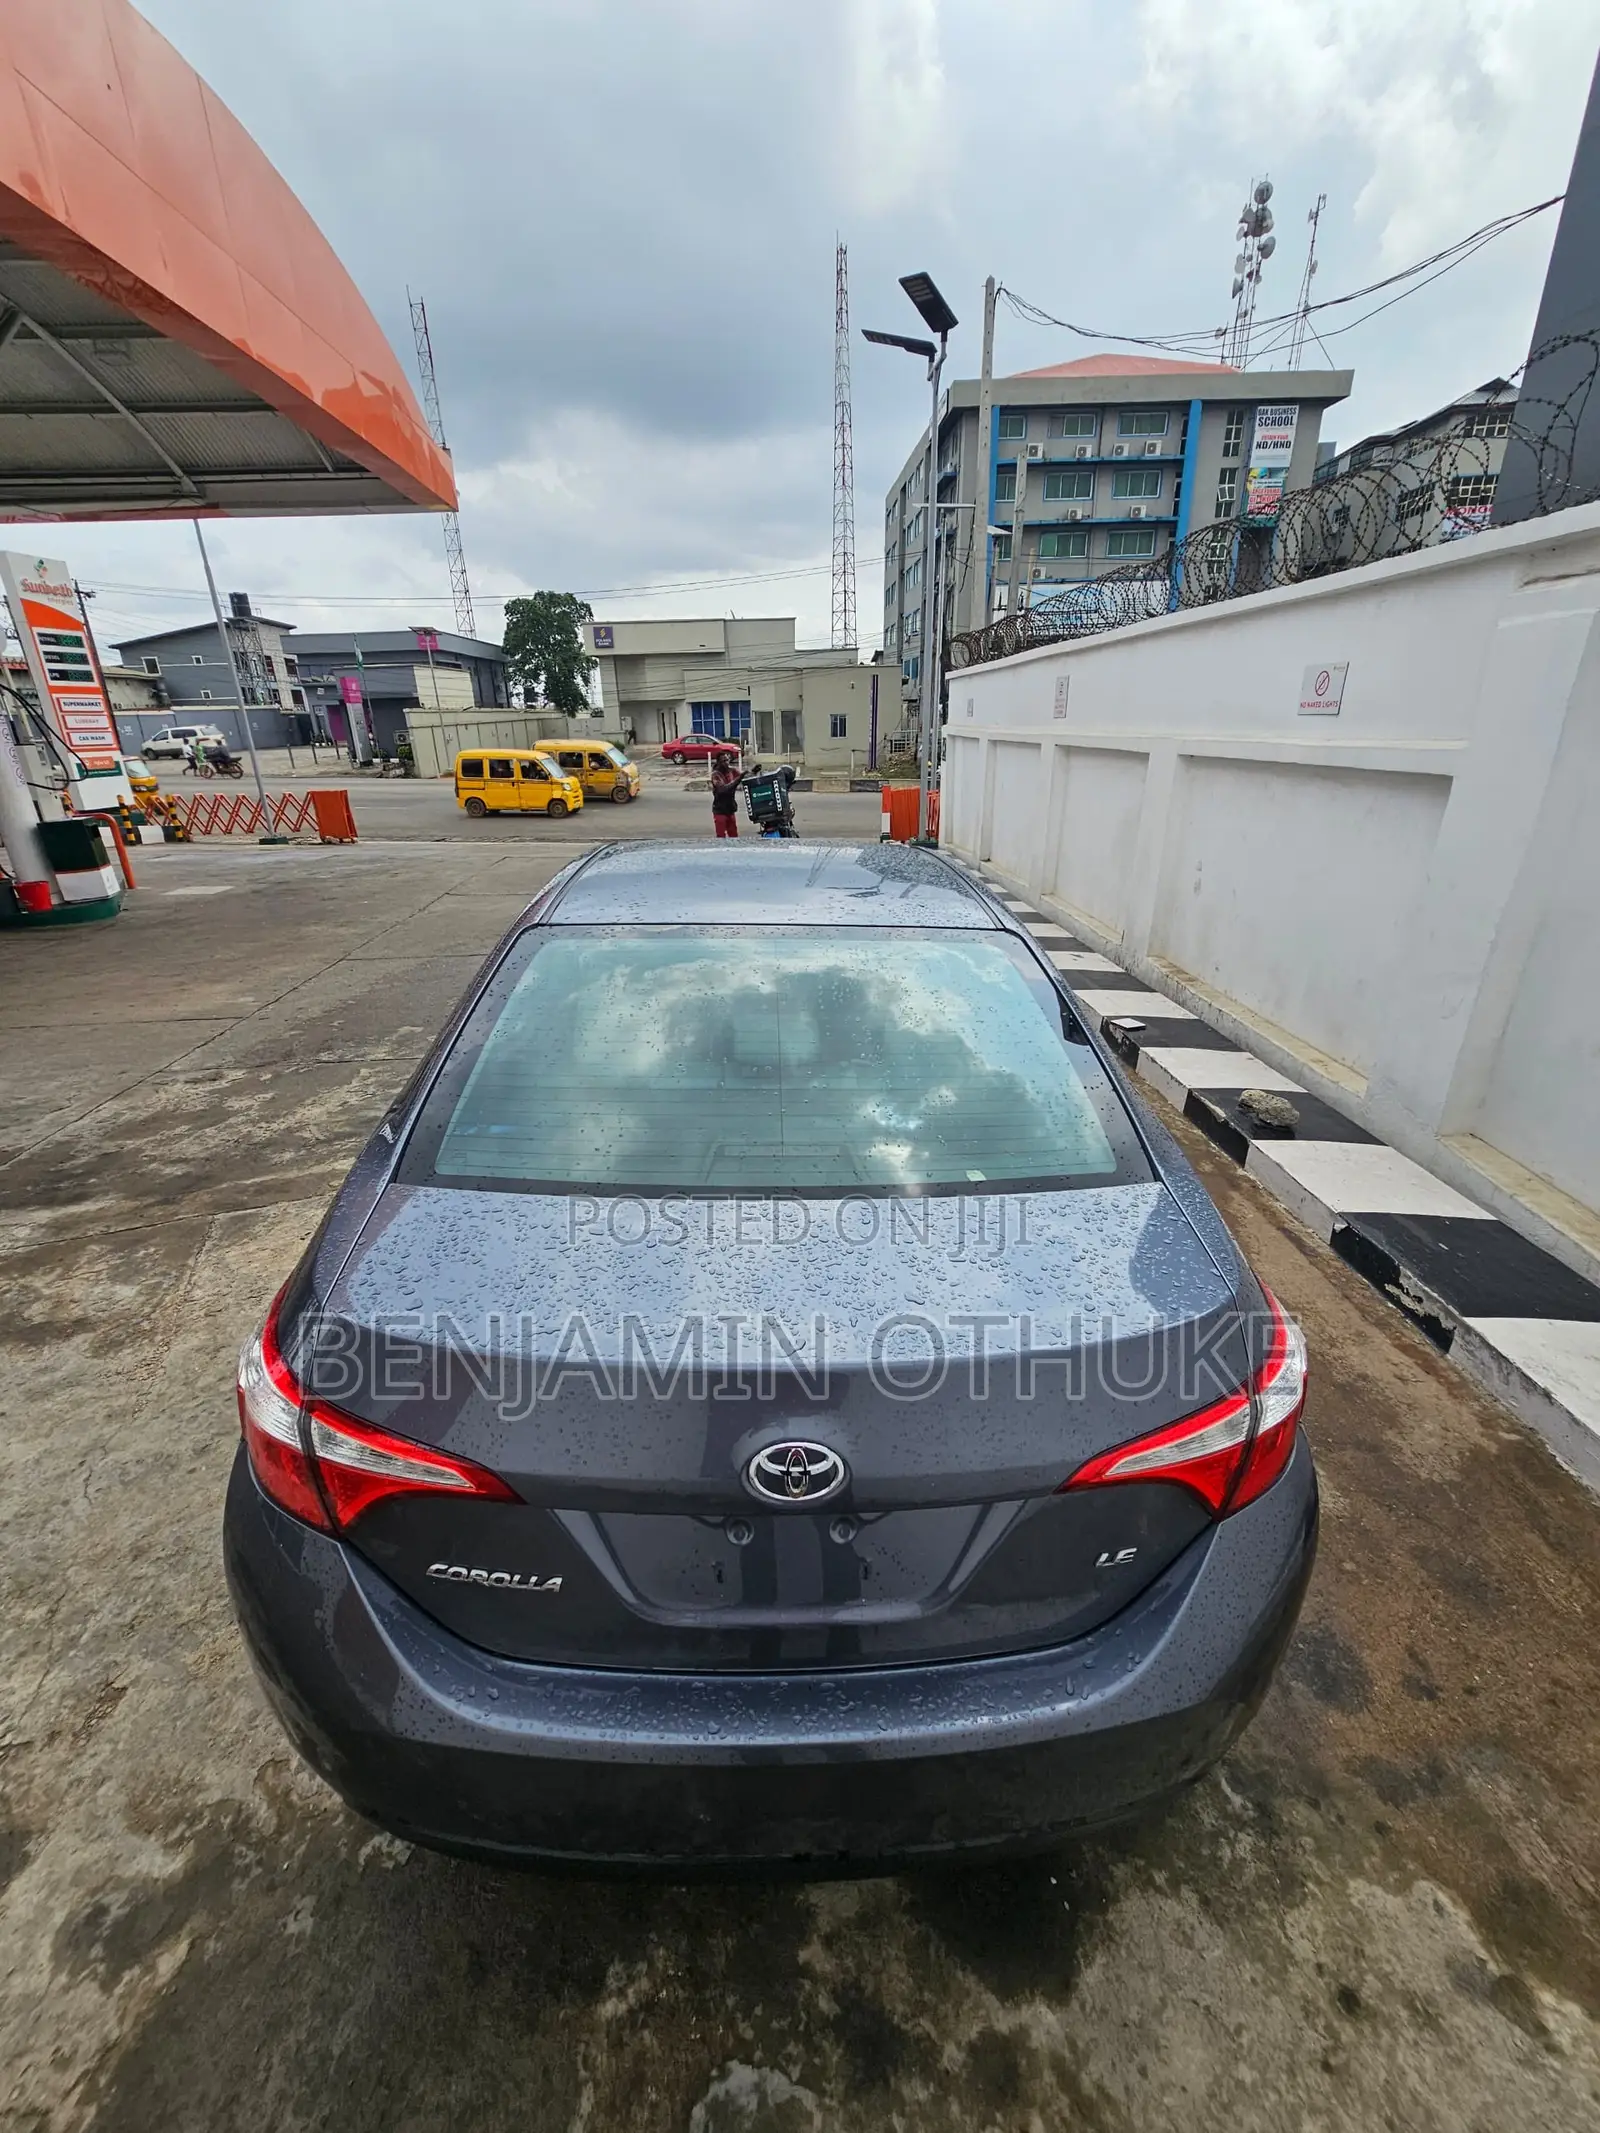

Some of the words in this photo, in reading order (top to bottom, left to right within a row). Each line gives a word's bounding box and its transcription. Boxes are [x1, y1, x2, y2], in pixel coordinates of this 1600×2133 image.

[1270, 406, 1297, 416] BUSINESS
[1258, 415, 1294, 427] SCHOOL
[1255, 440, 1292, 450] ND/HND
[1322, 700, 1339, 708] LIGHTS
[1095, 1547, 1138, 1568] LE
[425, 1562, 563, 1593] COROLLA
